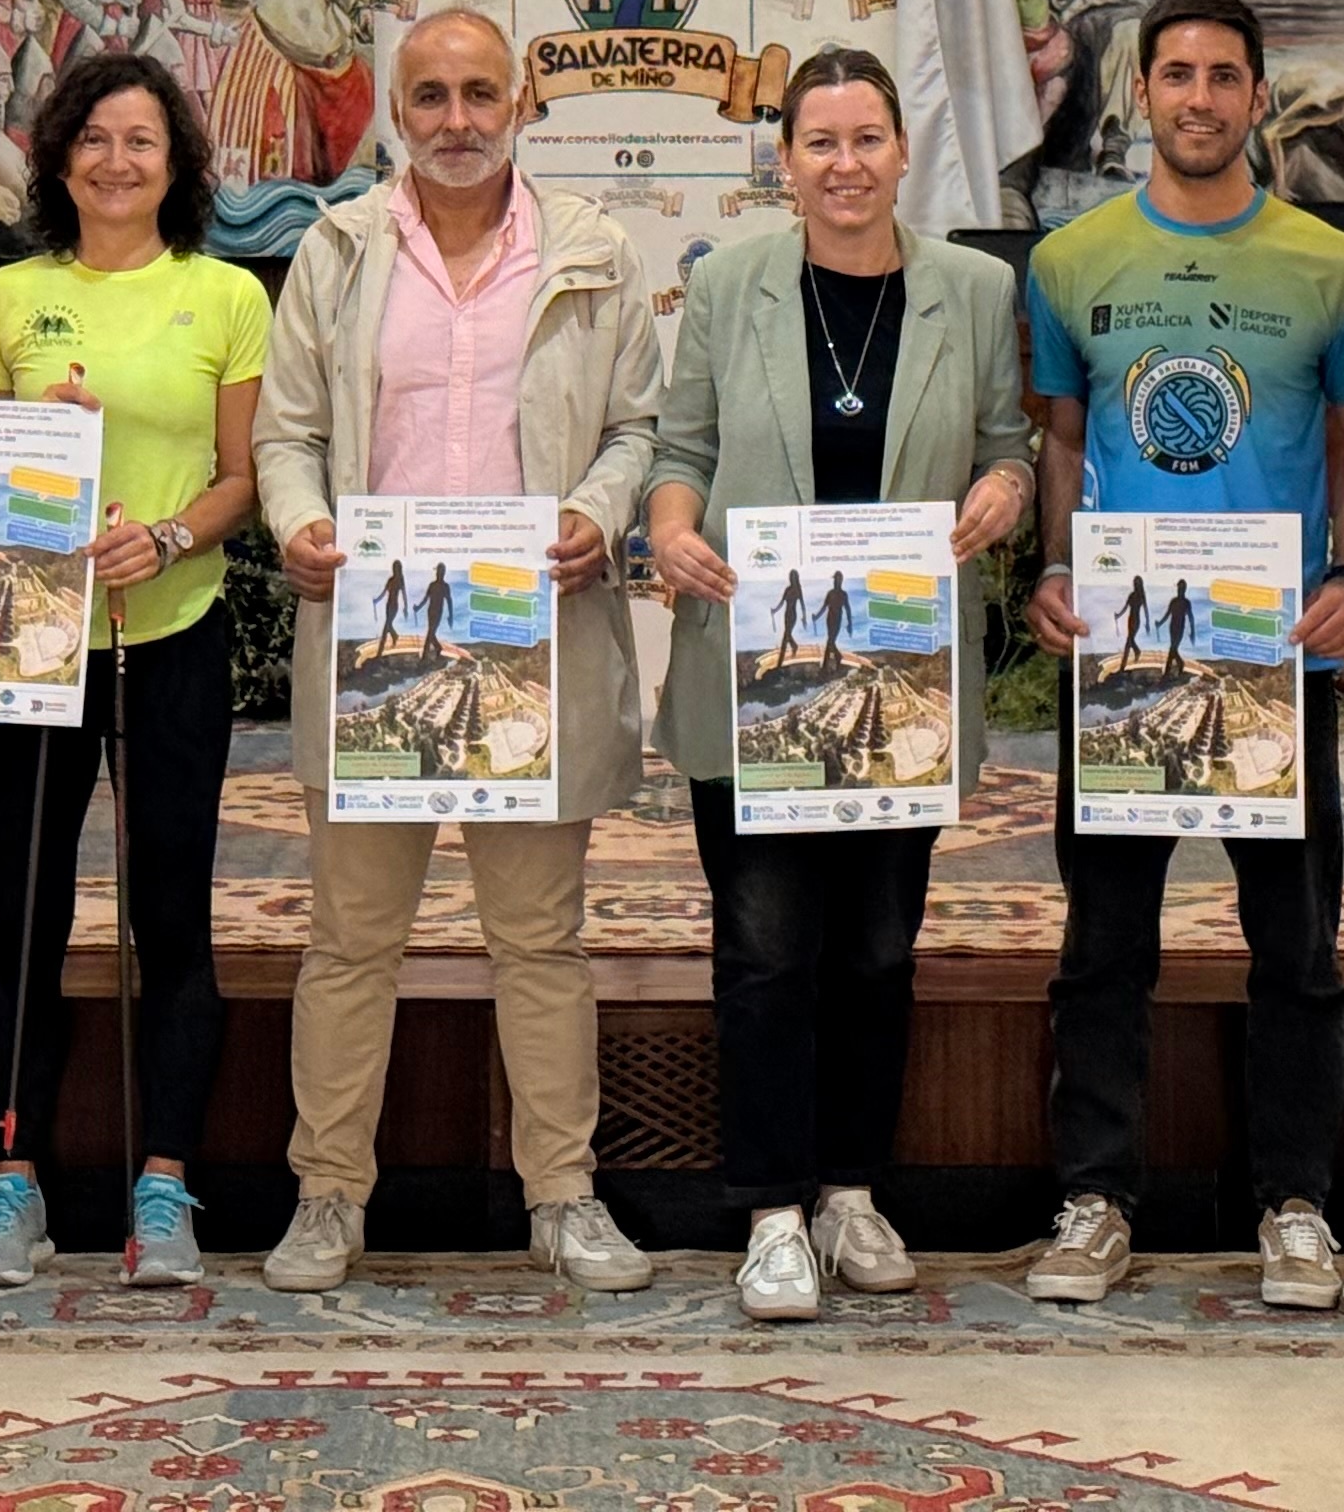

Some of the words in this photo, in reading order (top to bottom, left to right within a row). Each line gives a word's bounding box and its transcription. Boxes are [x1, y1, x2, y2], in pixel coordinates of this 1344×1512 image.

[537, 37, 727, 76] SALVATERRA
[592, 72, 615, 88] DE
[620, 67, 676, 88] MIÑO
[1115, 302, 1163, 316] XUNTA
[1114, 318, 1131, 330] DE
[1135, 315, 1192, 329] GALICIA
[1241, 308, 1292, 328] DEPORTE
[1240, 323, 1287, 338] GALEGO
[1172, 460, 1200, 472] FGM
